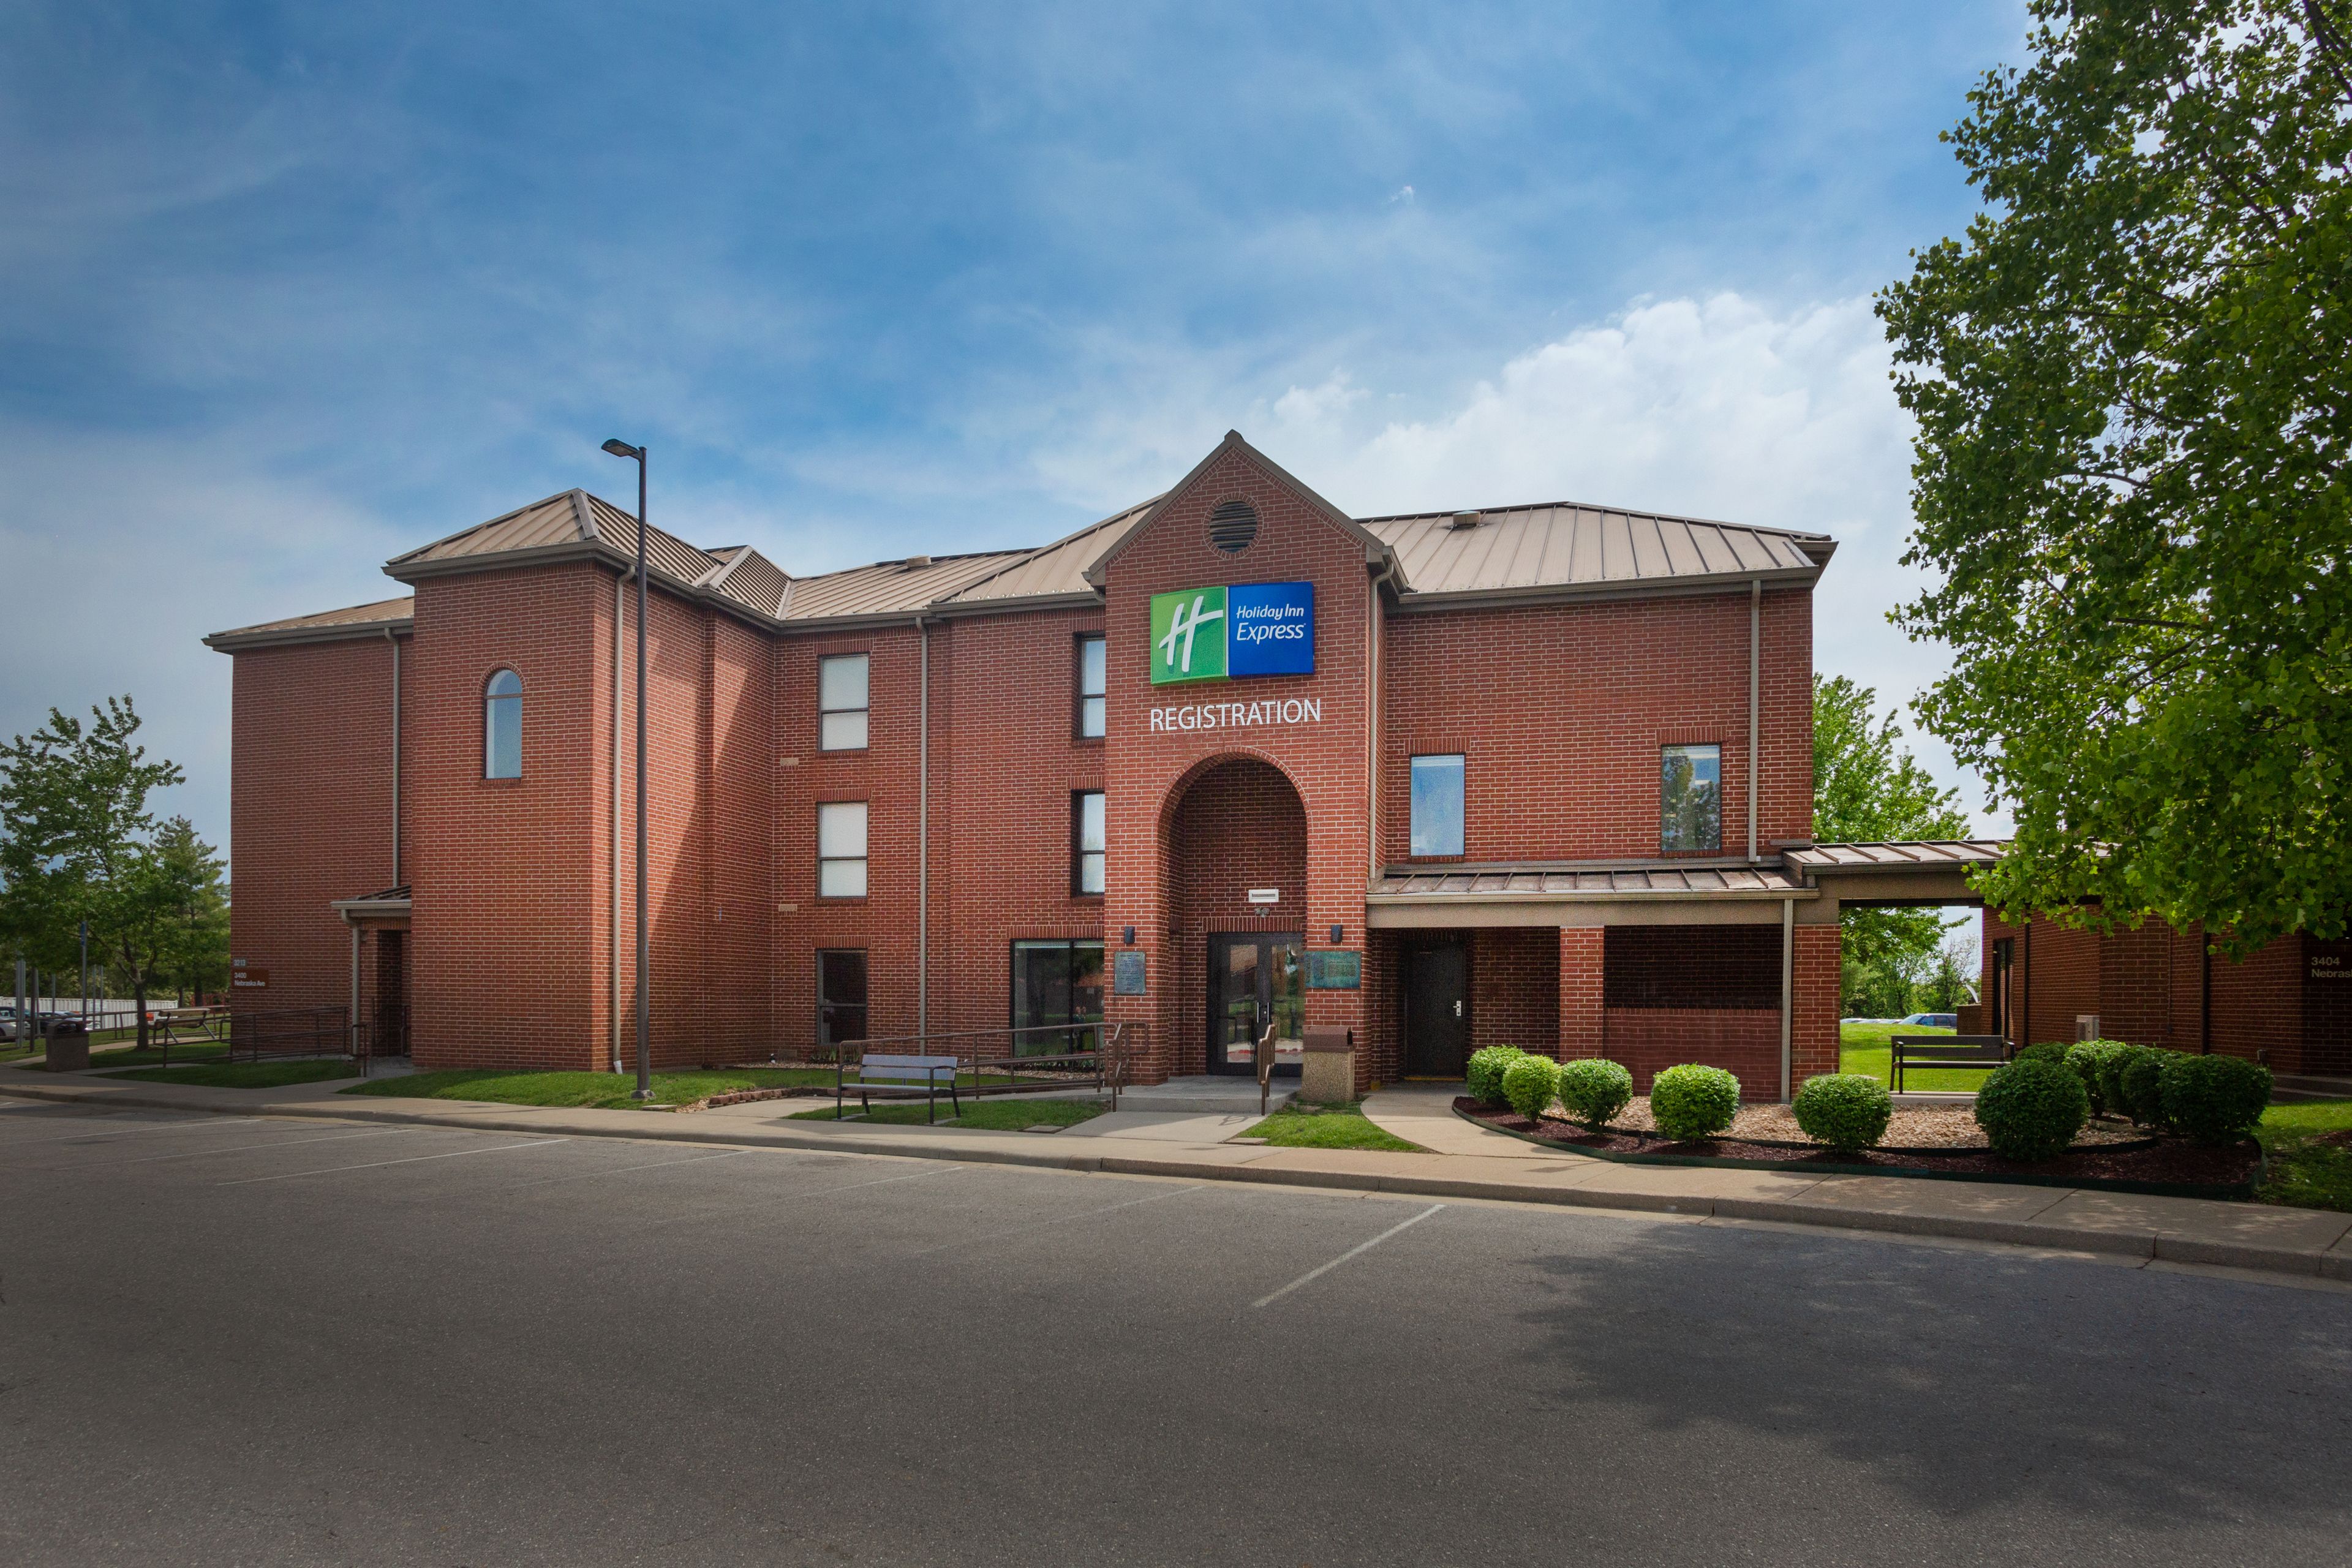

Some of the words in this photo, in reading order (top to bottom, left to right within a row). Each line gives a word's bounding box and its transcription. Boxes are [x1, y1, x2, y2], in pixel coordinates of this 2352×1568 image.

[1236, 605, 1283, 620] Holiday
[1284, 603, 1304, 617] Inn
[1237, 622, 1305, 645] Express
[1150, 698, 1321, 732] REGISTRATION
[2311, 956, 2340, 966] 3404
